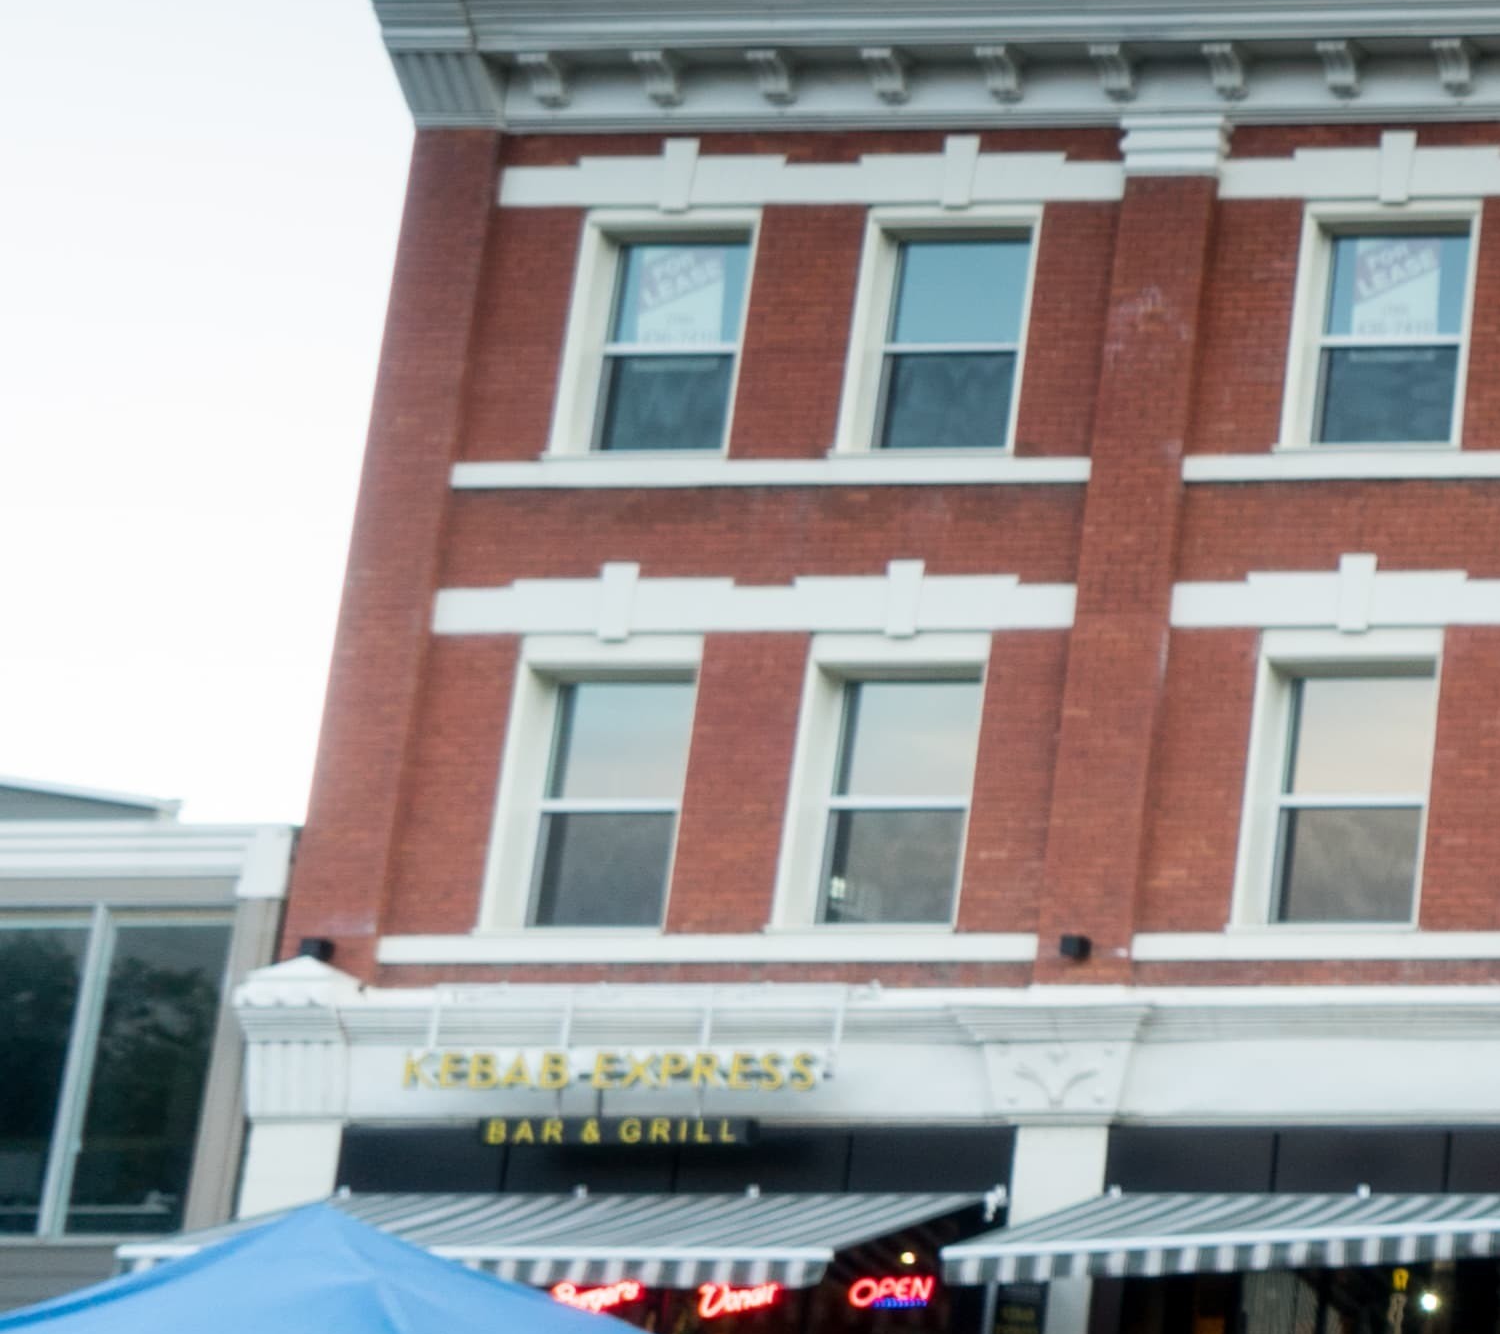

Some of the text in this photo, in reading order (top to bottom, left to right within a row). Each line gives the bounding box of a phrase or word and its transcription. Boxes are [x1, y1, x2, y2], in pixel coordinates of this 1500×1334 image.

[403, 1049, 818, 1090] KEBAB EXPRESS
[485, 1117, 738, 1144] BAR & GRILL
[849, 1276, 935, 1308] OPEN
